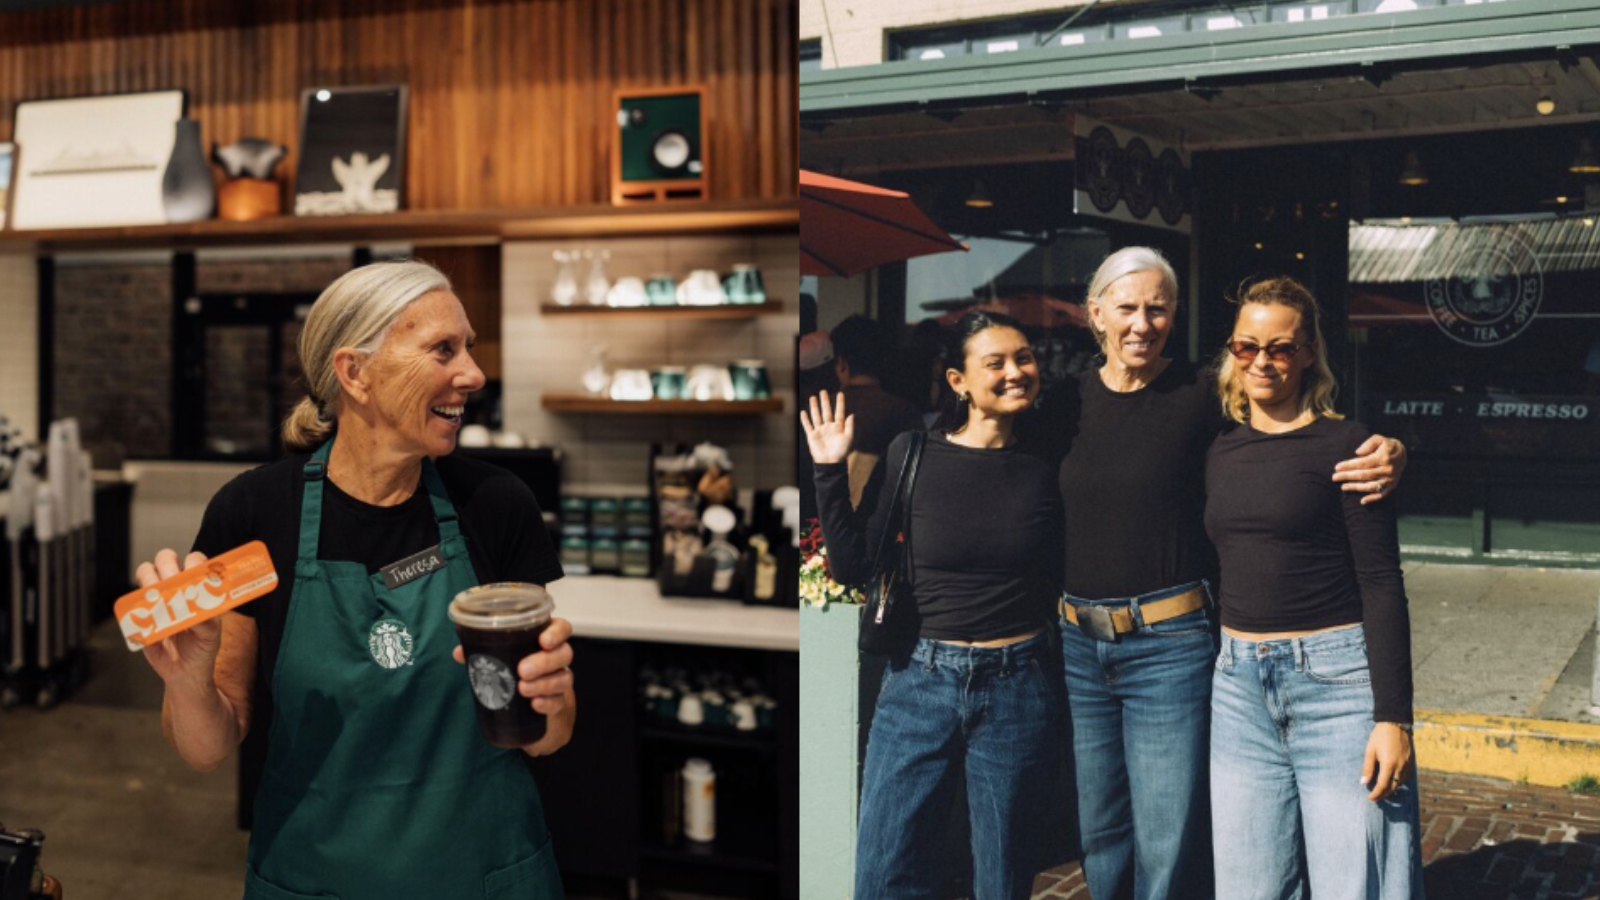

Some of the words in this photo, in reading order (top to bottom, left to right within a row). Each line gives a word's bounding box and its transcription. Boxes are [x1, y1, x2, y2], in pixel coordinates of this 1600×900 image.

[1473, 327, 1499, 340] TEA
[1514, 278, 1538, 322] SPICES
[1384, 401, 1444, 415] LATTE
[1476, 402, 1588, 419] ESPRESSO
[388, 555, 440, 582] Theresa
